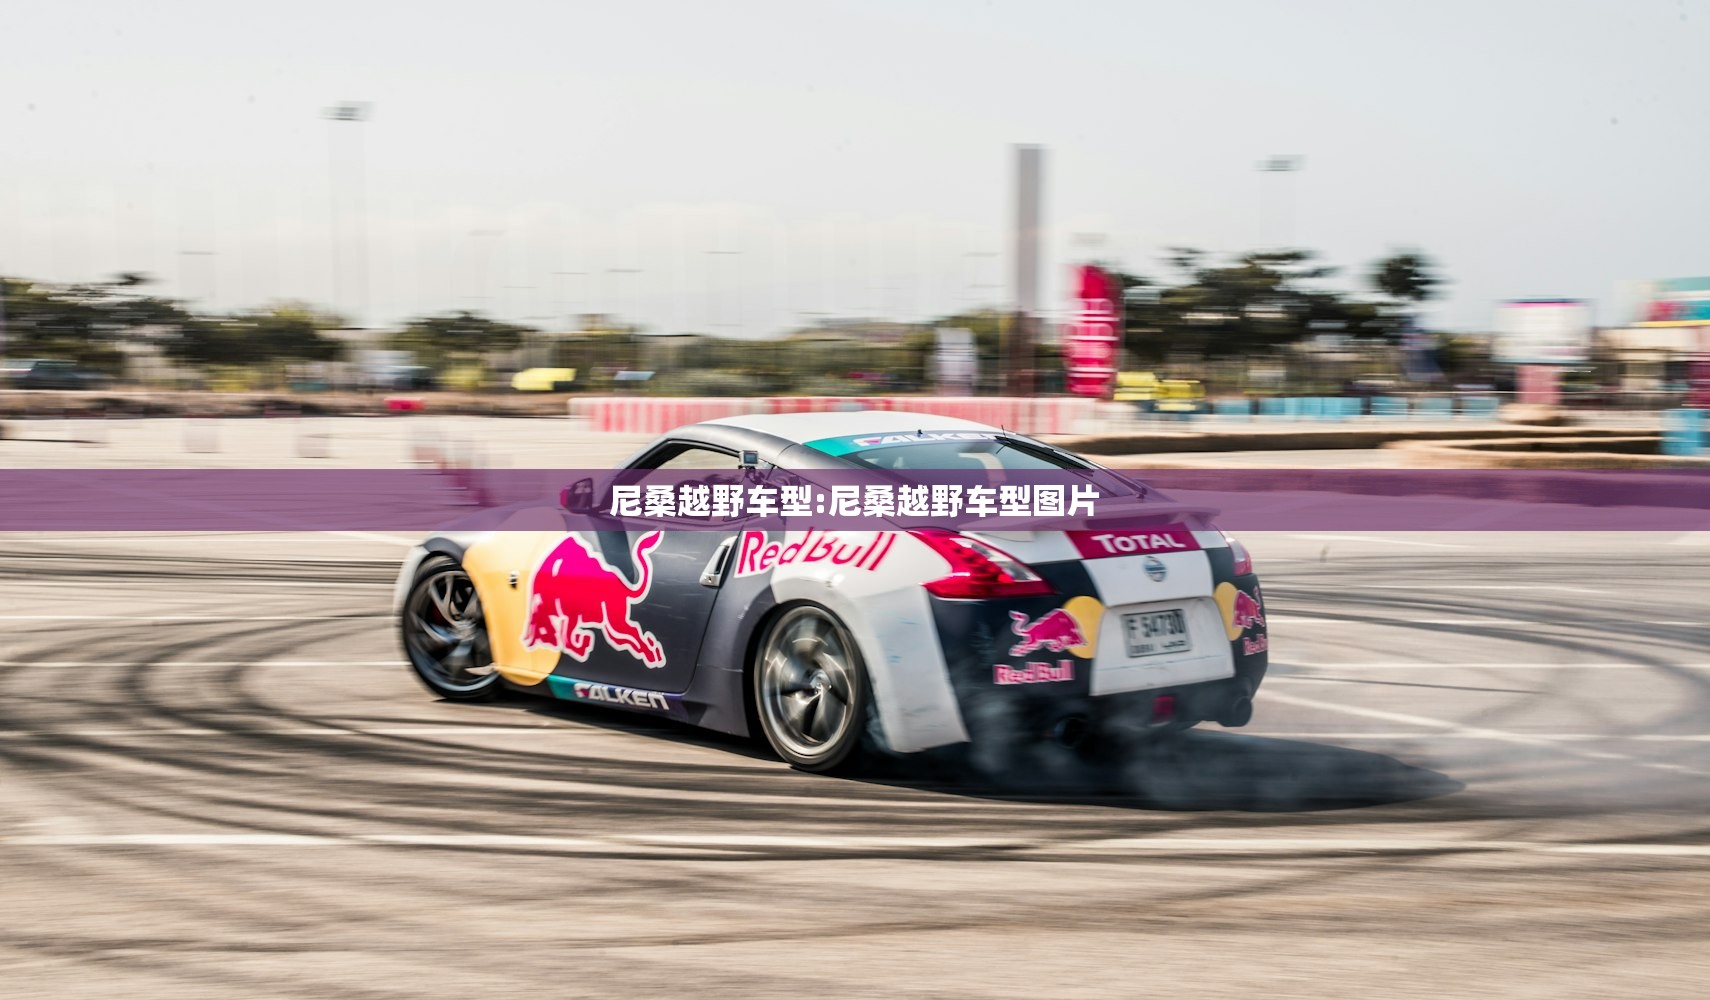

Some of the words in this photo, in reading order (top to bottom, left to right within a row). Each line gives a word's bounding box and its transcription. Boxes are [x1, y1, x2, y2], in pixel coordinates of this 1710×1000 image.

[737, 527, 814, 574] Red
[802, 529, 897, 571] Bull
[1090, 533, 1187, 553] TOTAL
[993, 662, 1036, 684] Red
[574, 682, 670, 711] FALKEN
